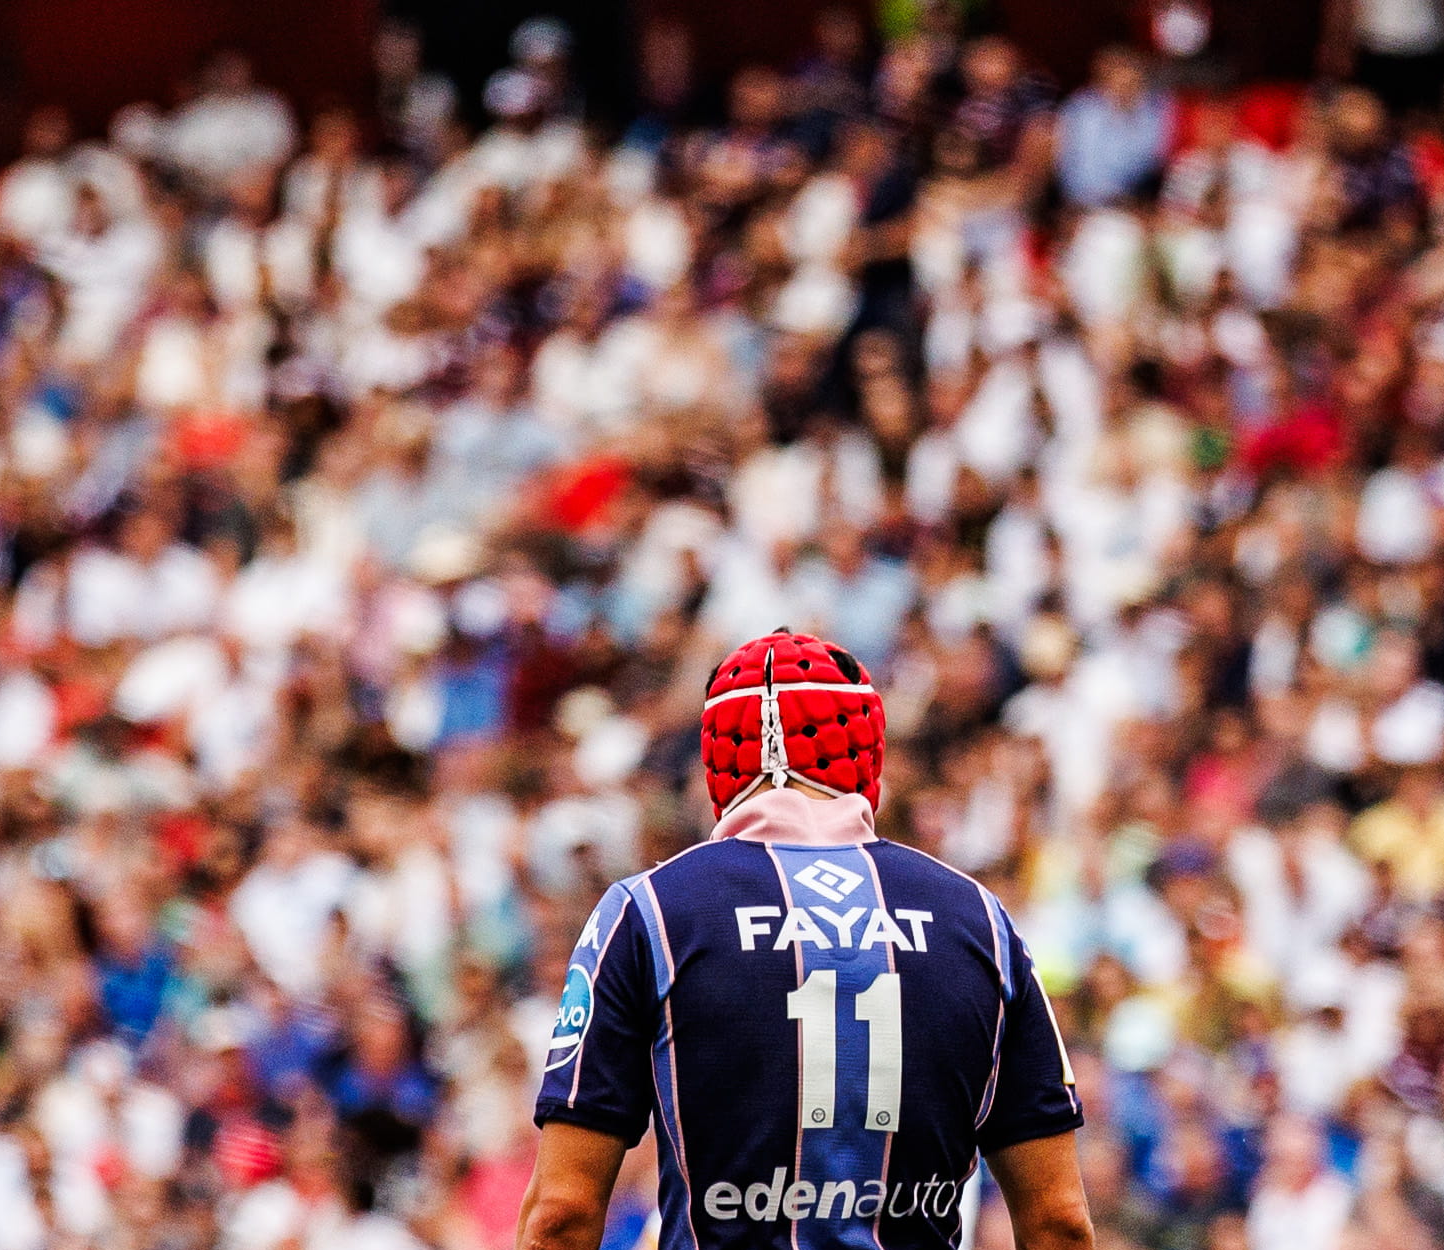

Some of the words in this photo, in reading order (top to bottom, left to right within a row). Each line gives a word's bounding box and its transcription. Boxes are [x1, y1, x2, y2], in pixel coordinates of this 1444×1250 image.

[734, 905, 934, 953] FAYAT
[786, 969, 903, 1133] 11
[703, 1166, 957, 1222] edenauto
